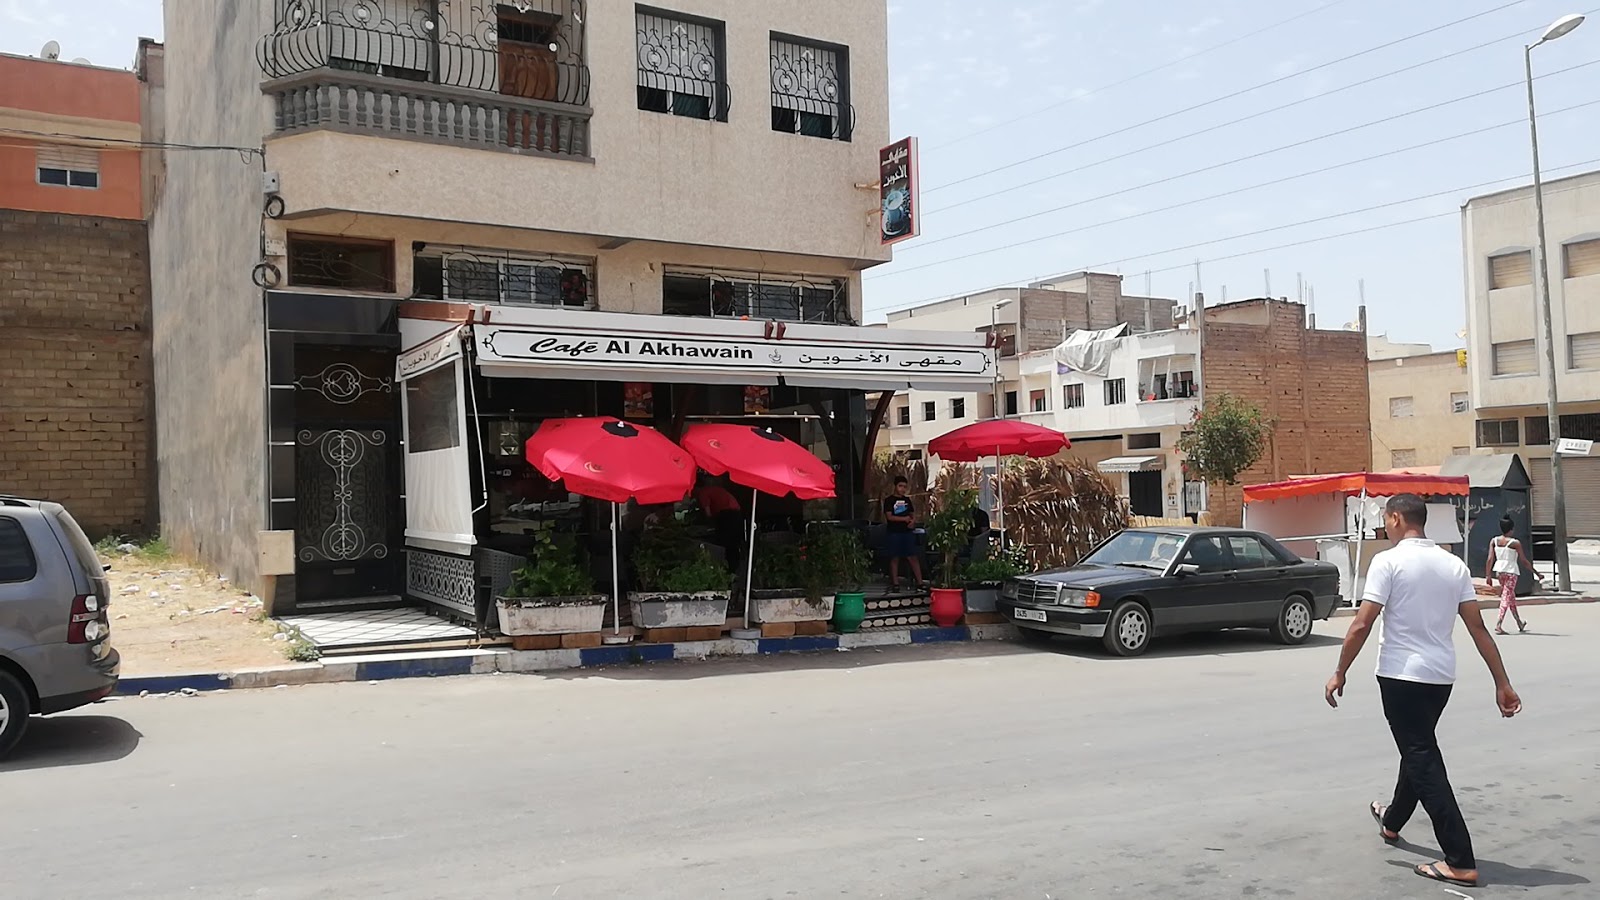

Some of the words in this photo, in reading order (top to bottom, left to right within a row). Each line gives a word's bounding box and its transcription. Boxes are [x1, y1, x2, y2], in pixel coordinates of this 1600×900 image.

[529, 337, 598, 357] Café
[605, 340, 630, 354] Al
[638, 342, 753, 359] Akhawain
[899, 355, 962, 368] مقهى
